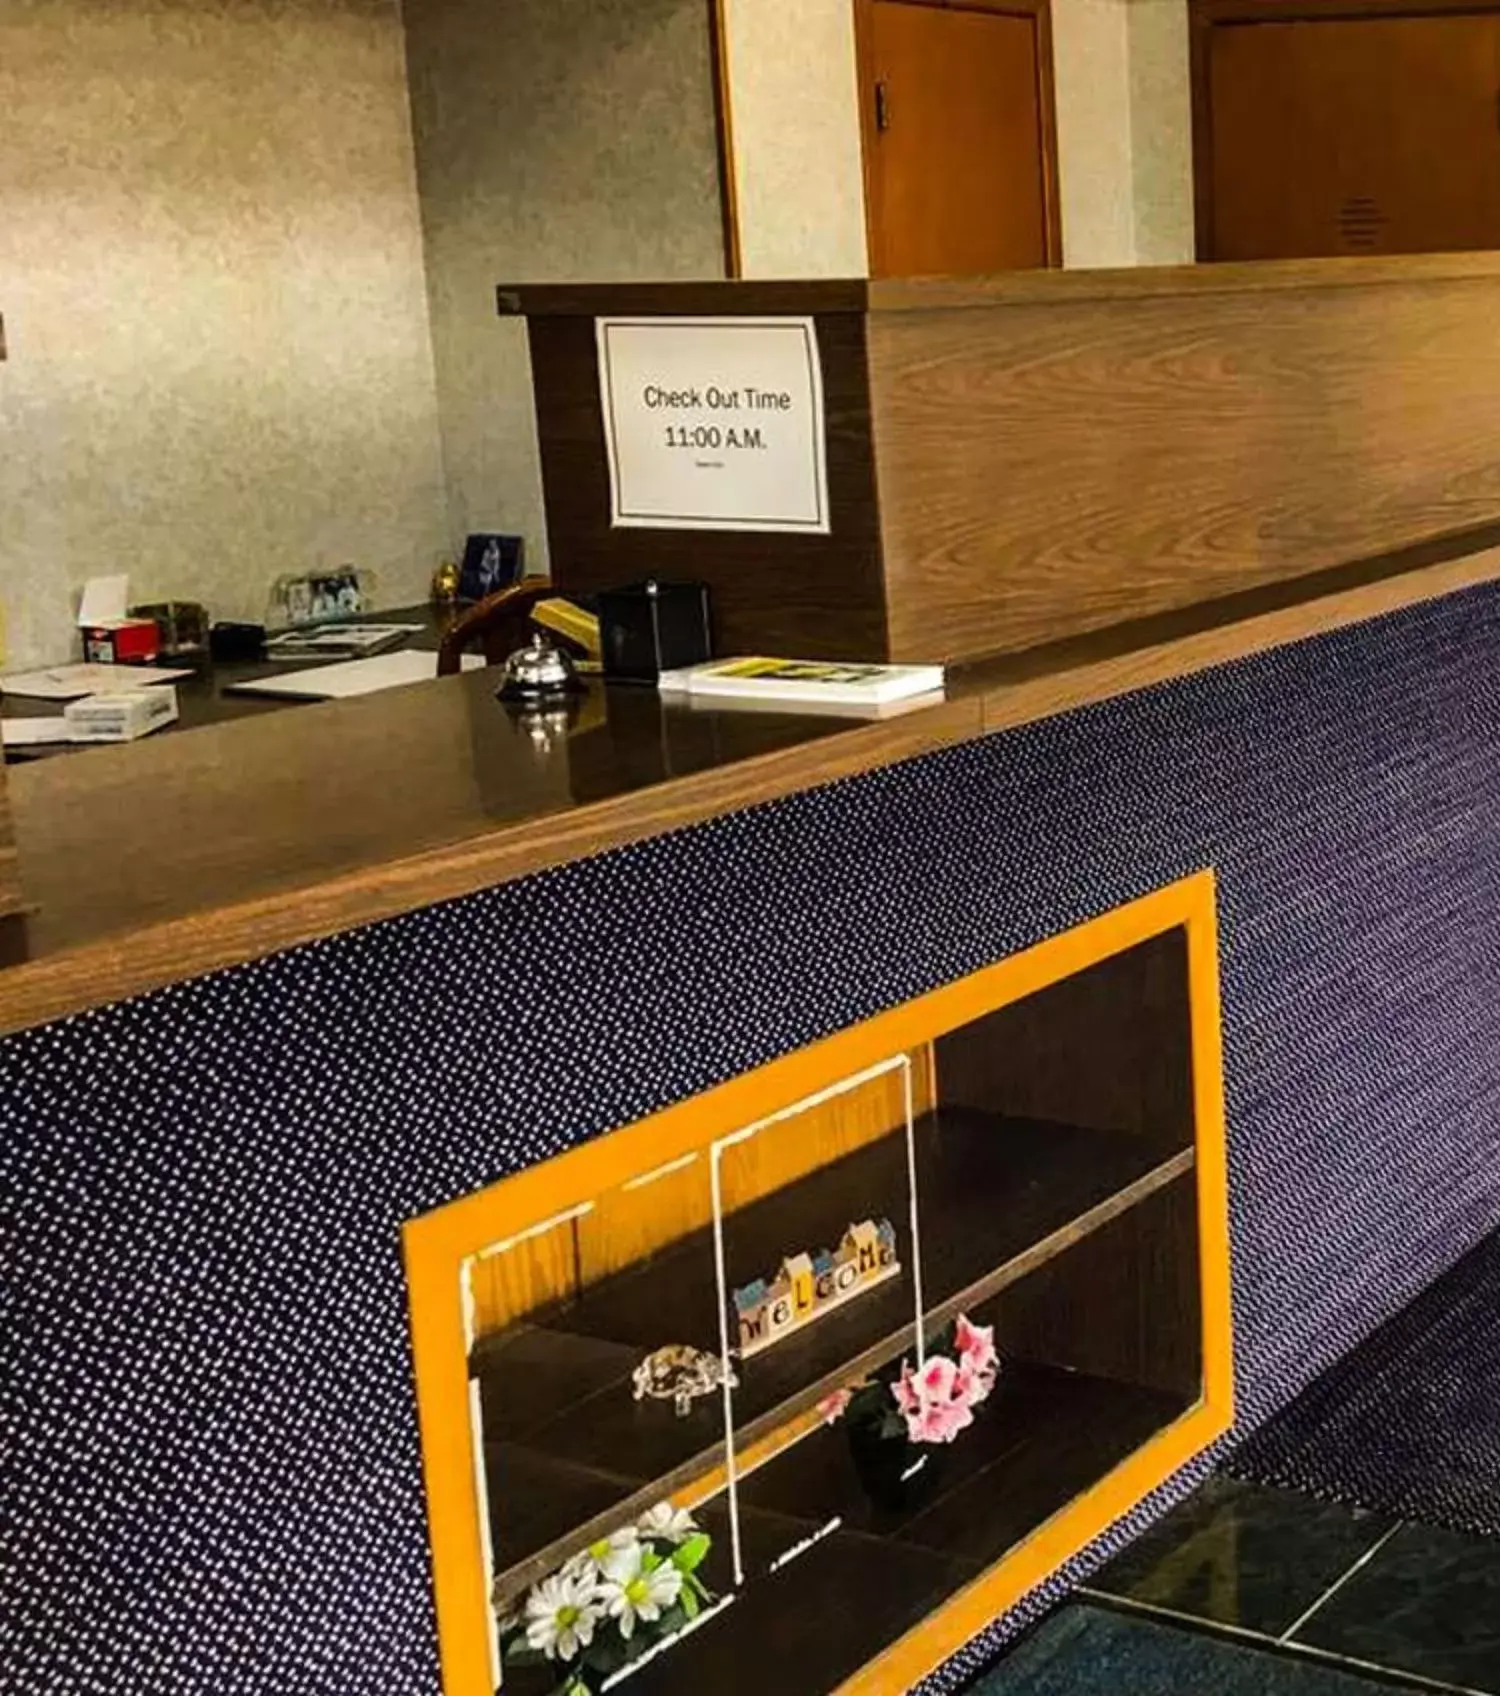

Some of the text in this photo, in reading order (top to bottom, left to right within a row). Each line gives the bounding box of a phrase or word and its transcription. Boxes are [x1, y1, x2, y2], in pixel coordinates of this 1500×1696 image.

[644, 385, 792, 410] Check Out Time
[665, 426, 767, 449] 11:00 A.M.
